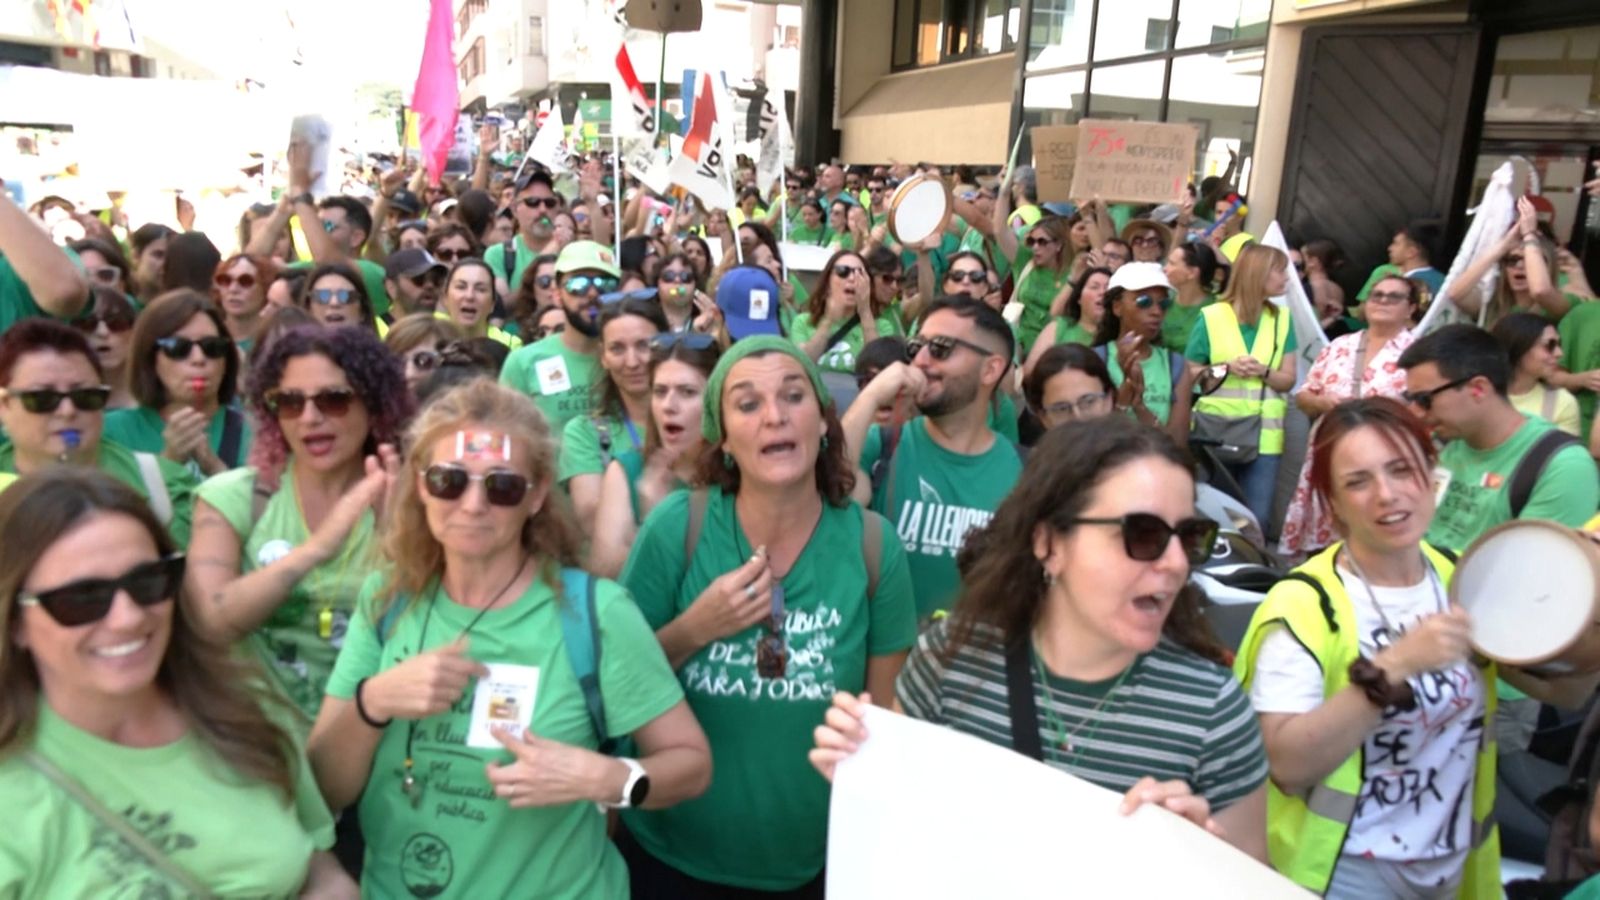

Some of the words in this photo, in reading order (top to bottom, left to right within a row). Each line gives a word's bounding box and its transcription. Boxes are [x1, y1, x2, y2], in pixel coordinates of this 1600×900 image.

[897, 500, 923, 541] LA
[685, 663, 747, 696] PARA
[1367, 727, 1414, 766] SE
